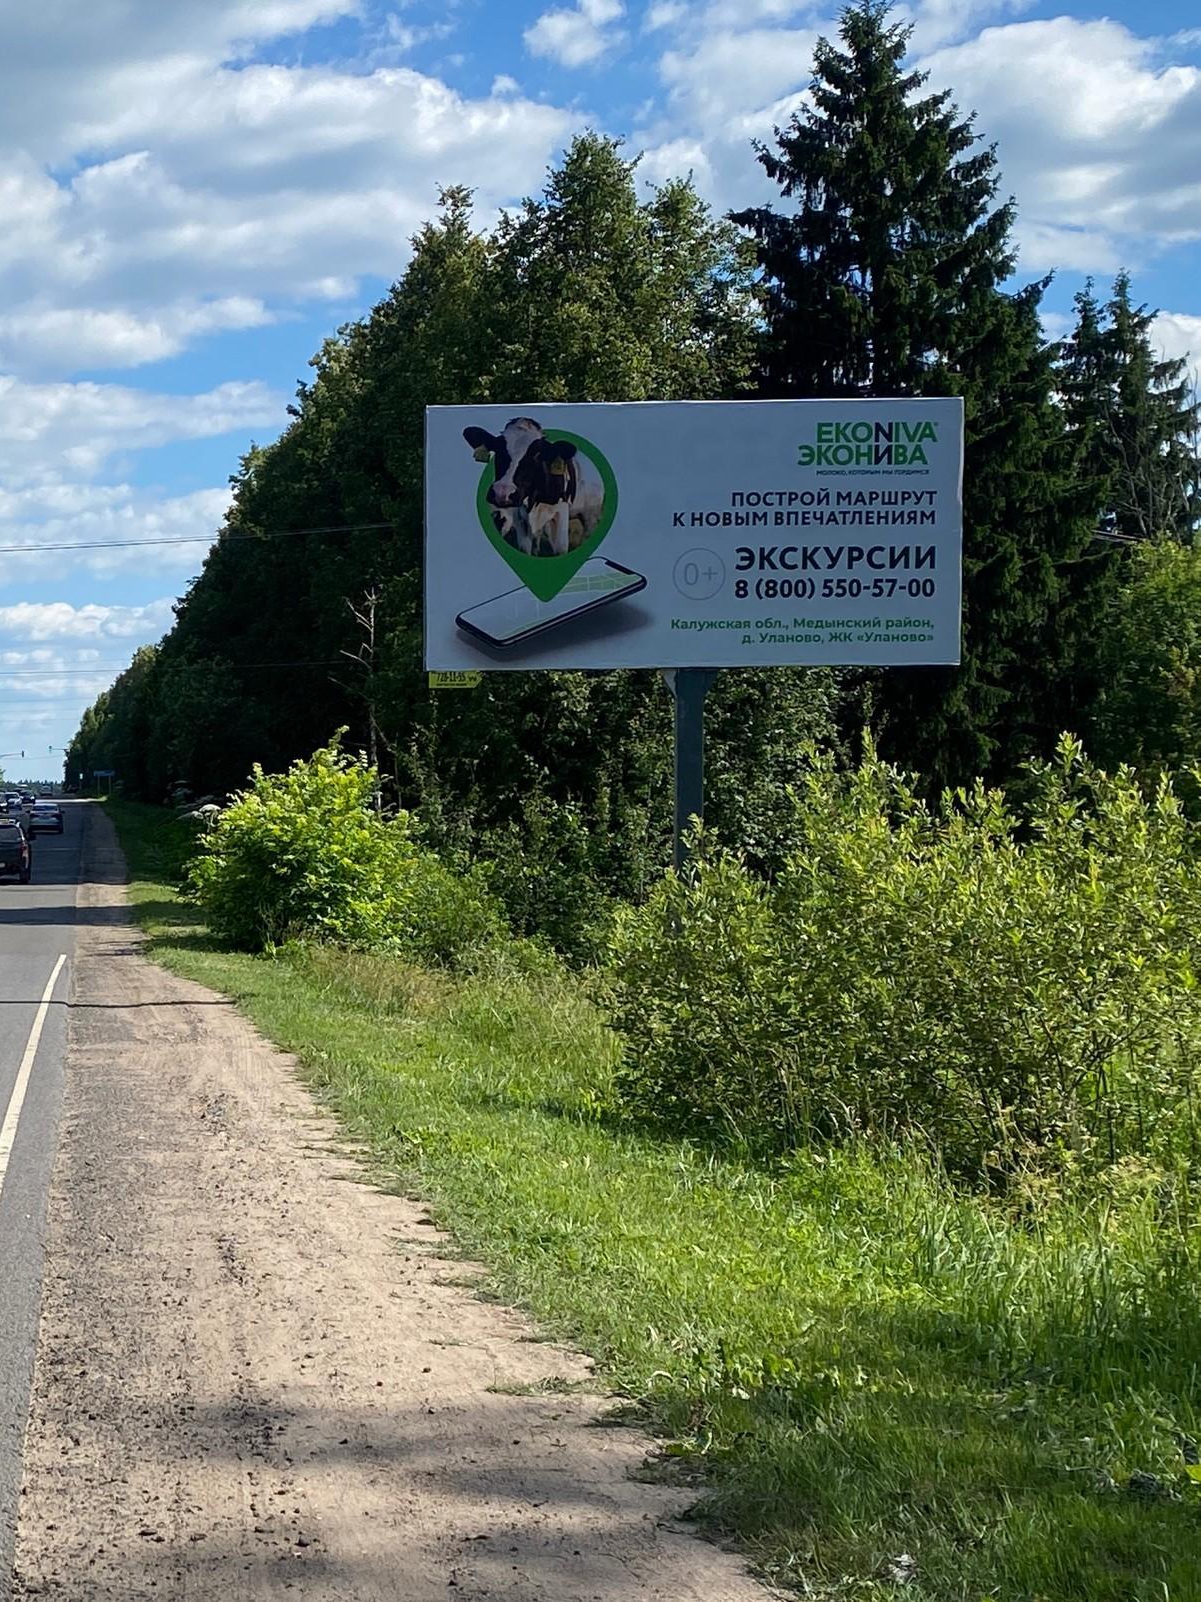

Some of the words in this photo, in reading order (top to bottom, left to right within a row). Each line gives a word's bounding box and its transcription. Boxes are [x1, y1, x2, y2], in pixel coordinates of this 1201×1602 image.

[817, 421, 937, 443] EKONIVA
[797, 444, 928, 466] ЭКОНИВА
[731, 487, 830, 507] ПОСТРОЙ
[836, 490, 938, 506] МАРШРУТ
[673, 511, 686, 527] К
[690, 511, 768, 527] НОВЫМ
[774, 510, 936, 526] ВПЕЧАТЛЕНИЯМ
[734, 545, 936, 571] ЭКСКУРСИИ
[734, 579, 749, 599] 8
[755, 577, 816, 600] (800)
[821, 578, 936, 598] 550-57-00
[670, 618, 751, 632] Калужская
[755, 617, 789, 631] обл.,
[793, 617, 881, 630] Медынский
[885, 617, 935, 630] район,
[741, 634, 755, 645] д.
[758, 632, 824, 644] Уланово,
[828, 631, 854, 643] ЖК
[857, 631, 935, 643] «Уланово»
